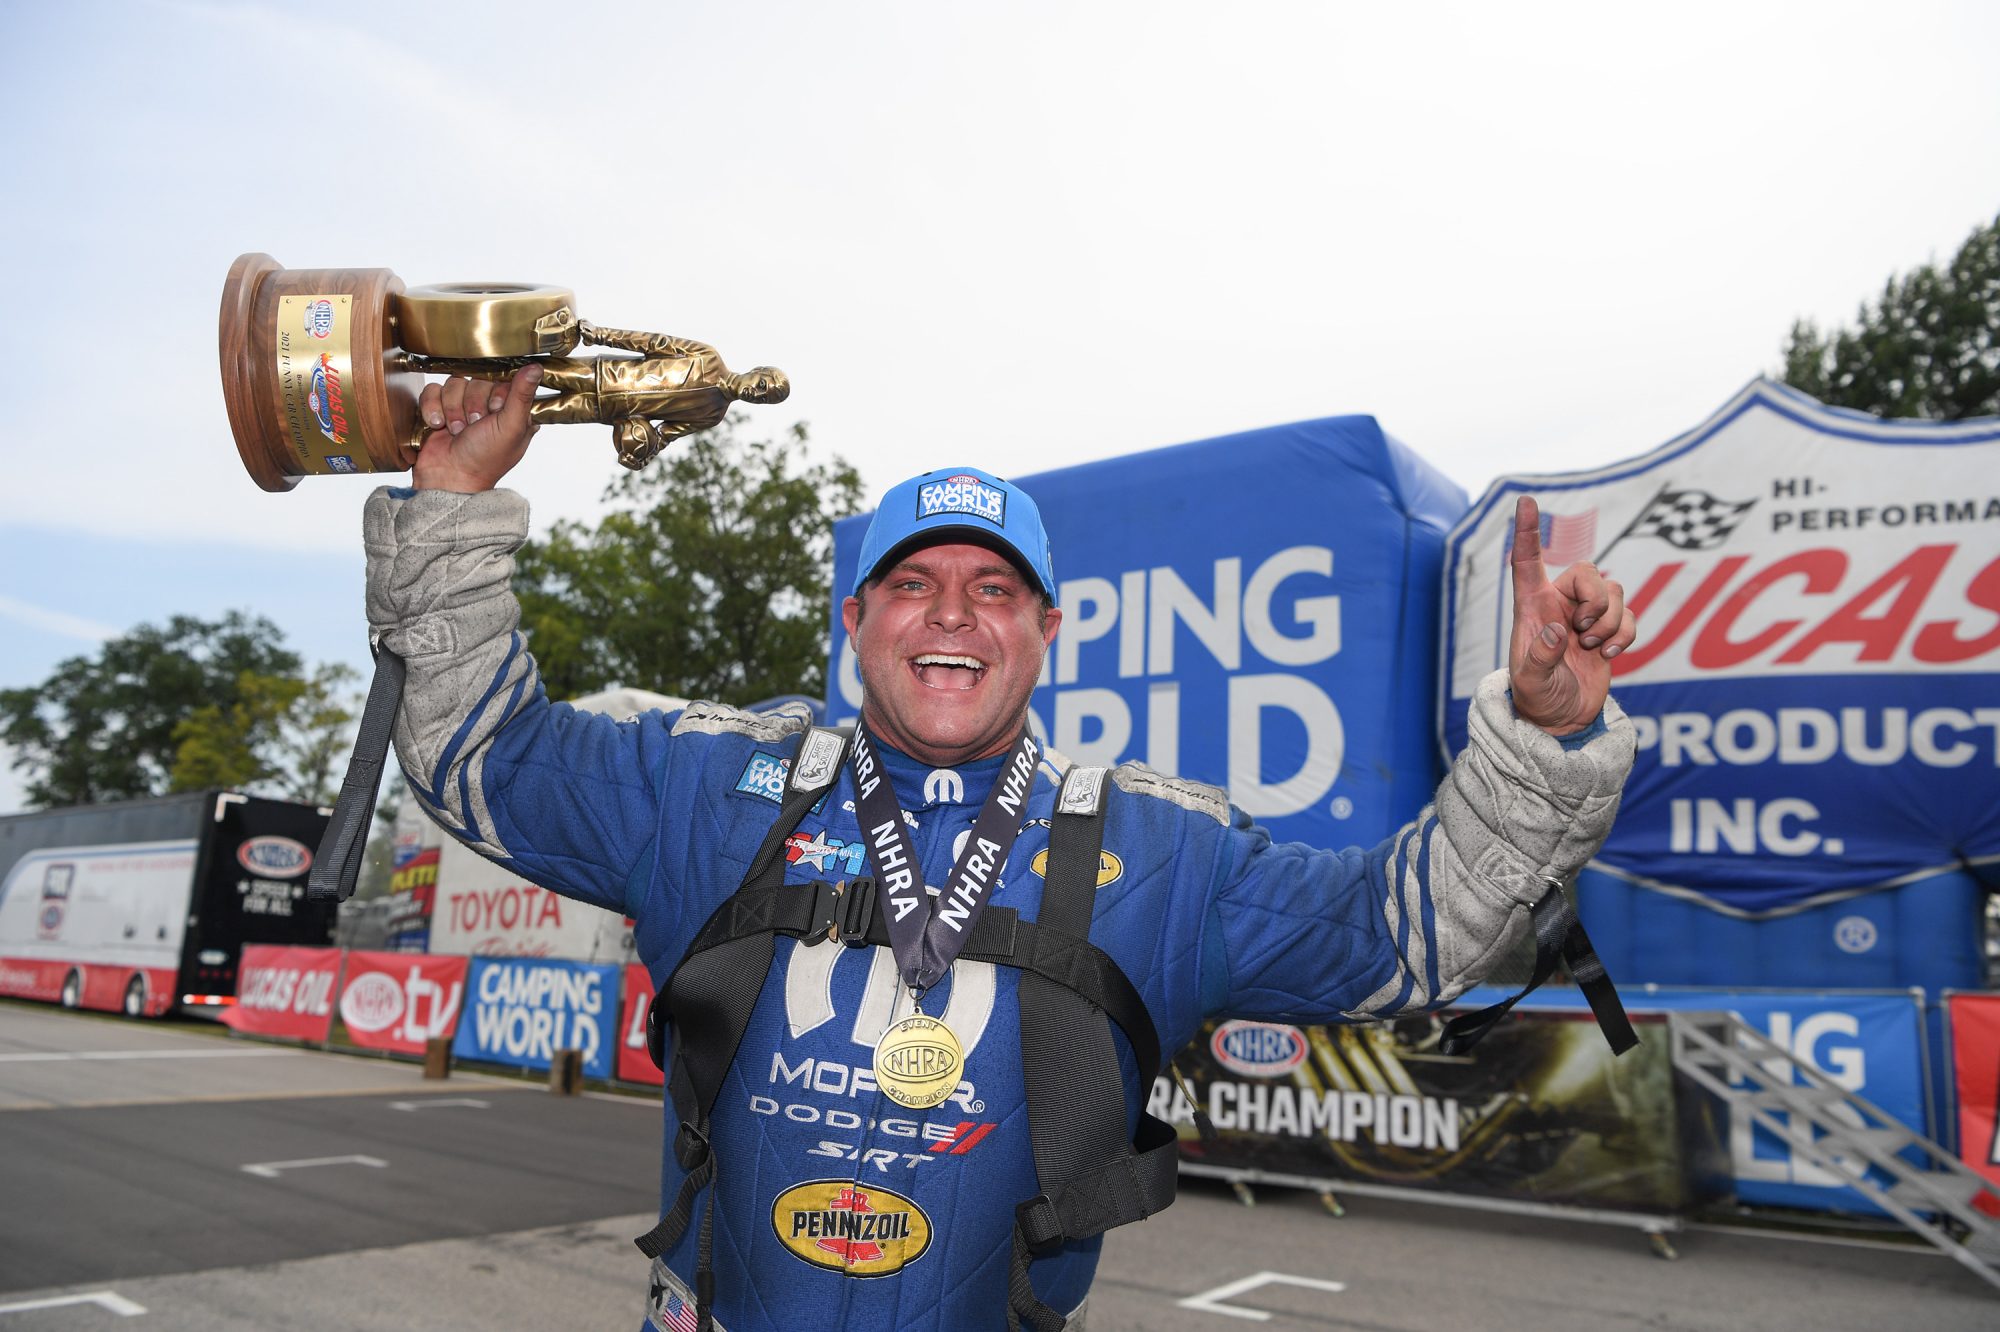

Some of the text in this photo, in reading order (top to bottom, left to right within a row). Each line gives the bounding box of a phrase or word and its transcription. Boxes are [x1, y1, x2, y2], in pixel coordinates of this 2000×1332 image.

[314, 304, 331, 335] NHRA
[281, 331, 293, 351] 2021
[281, 354, 294, 391] FUNNY
[286, 393, 297, 415] CAR
[324, 364, 350, 435] LUCAS OIL
[921, 483, 1002, 505] CAMPING
[922, 492, 1002, 516] WORLD
[1771, 476, 1828, 498] HI-
[1600, 541, 2000, 678] UCAS
[996, 736, 1038, 816] NHRA
[1669, 797, 1844, 855] INC.
[839, 848, 861, 859] MILE
[871, 819, 919, 922] NHRA
[938, 837, 1001, 933] NHRA
[450, 886, 562, 933] TOYOTA
[240, 966, 334, 1017] LUCAS OIL
[478, 963, 601, 1014] CAMPING
[476, 1003, 601, 1064] WORLD
[899, 1019, 938, 1032] EVENT
[890, 1047, 948, 1075] NHRA
[1227, 1029, 1292, 1062] NHRA
[887, 1082, 953, 1105] CHAMPION
[749, 1094, 957, 1142] DODGE
[1208, 1081, 1459, 1151] CHAMPION
[806, 1140, 935, 1172] SRT
[792, 1211, 911, 1241] PENNZOIL
